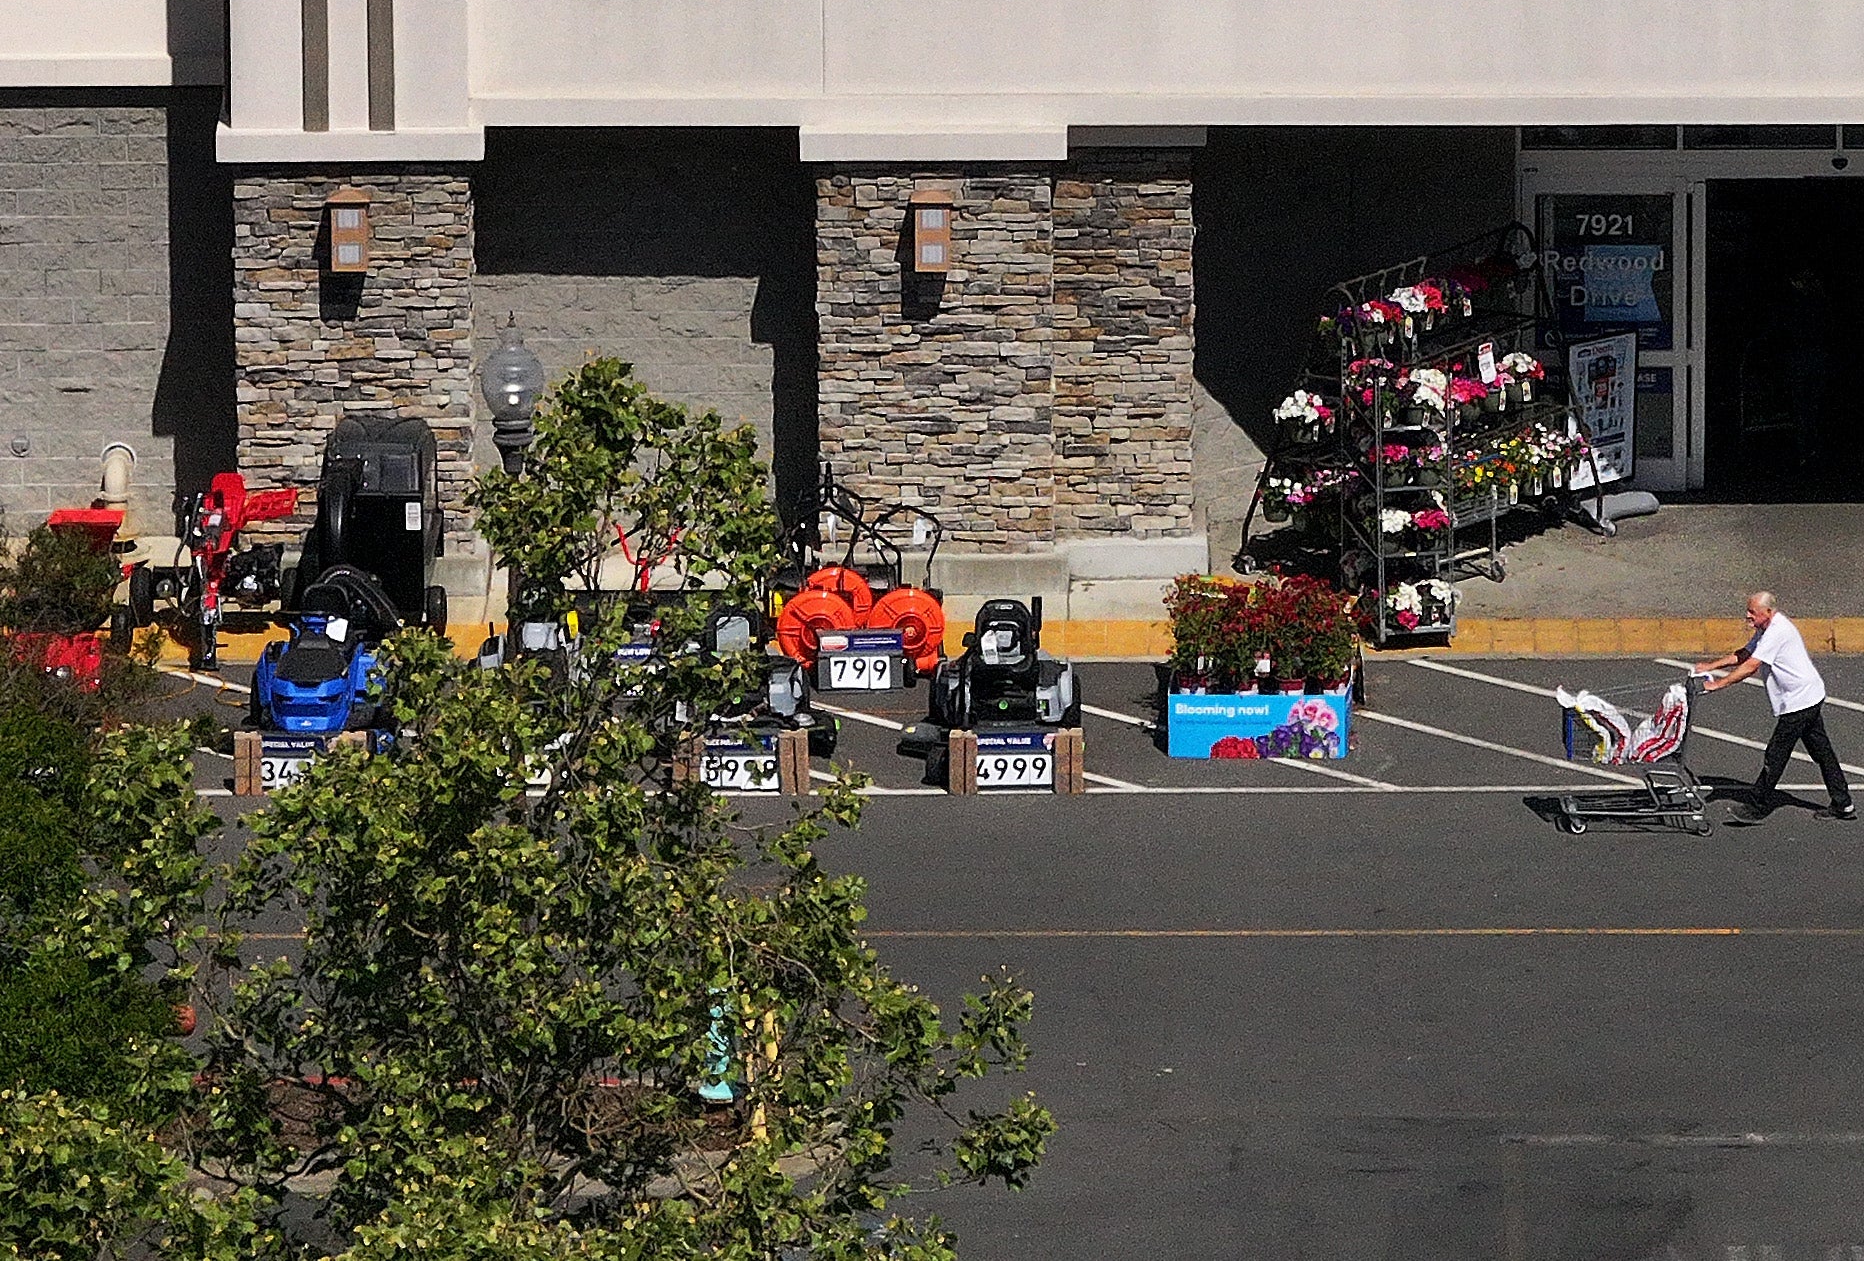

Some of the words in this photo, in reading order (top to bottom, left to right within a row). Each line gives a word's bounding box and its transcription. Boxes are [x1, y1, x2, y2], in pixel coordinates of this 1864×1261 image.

[1576, 214, 1634, 236] 7921
[1544, 250, 1665, 271] Redwood
[1570, 285, 1639, 307] Drive
[833, 658, 888, 682] 799
[1175, 703, 1236, 718] Blooming
[1238, 703, 1270, 715] now!
[977, 757, 1047, 781] 4999
